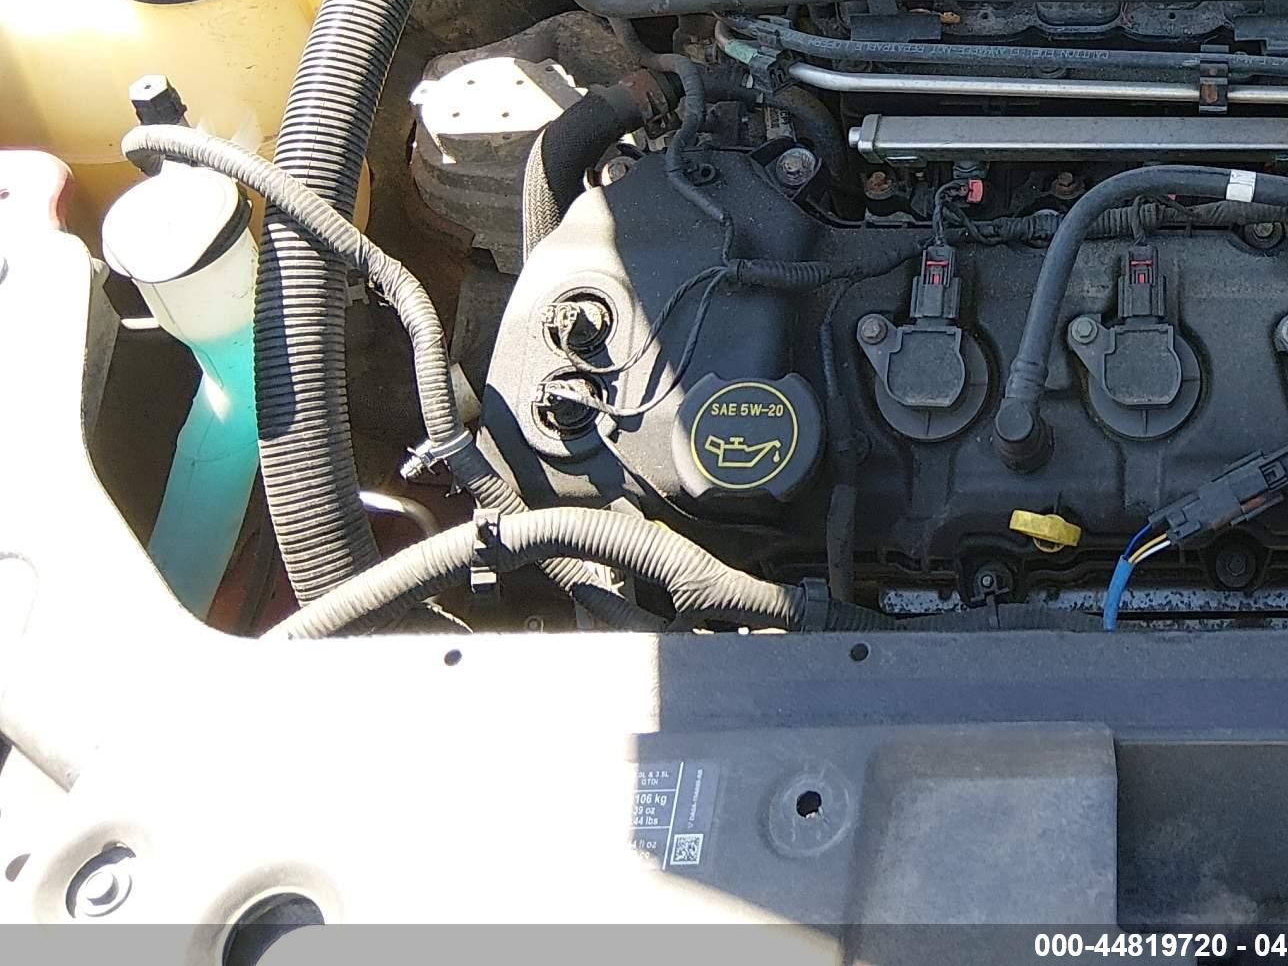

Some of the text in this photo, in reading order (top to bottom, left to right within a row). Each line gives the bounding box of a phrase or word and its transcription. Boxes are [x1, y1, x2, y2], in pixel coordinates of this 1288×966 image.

[1031, 48, 1056, 58] FUEL
[1060, 49, 1109, 59] CAUTION
[710, 403, 784, 417] SAE 5W-20
[655, 794, 667, 806] kg
[645, 807, 656, 815] oz
[645, 816, 658, 825] lbs
